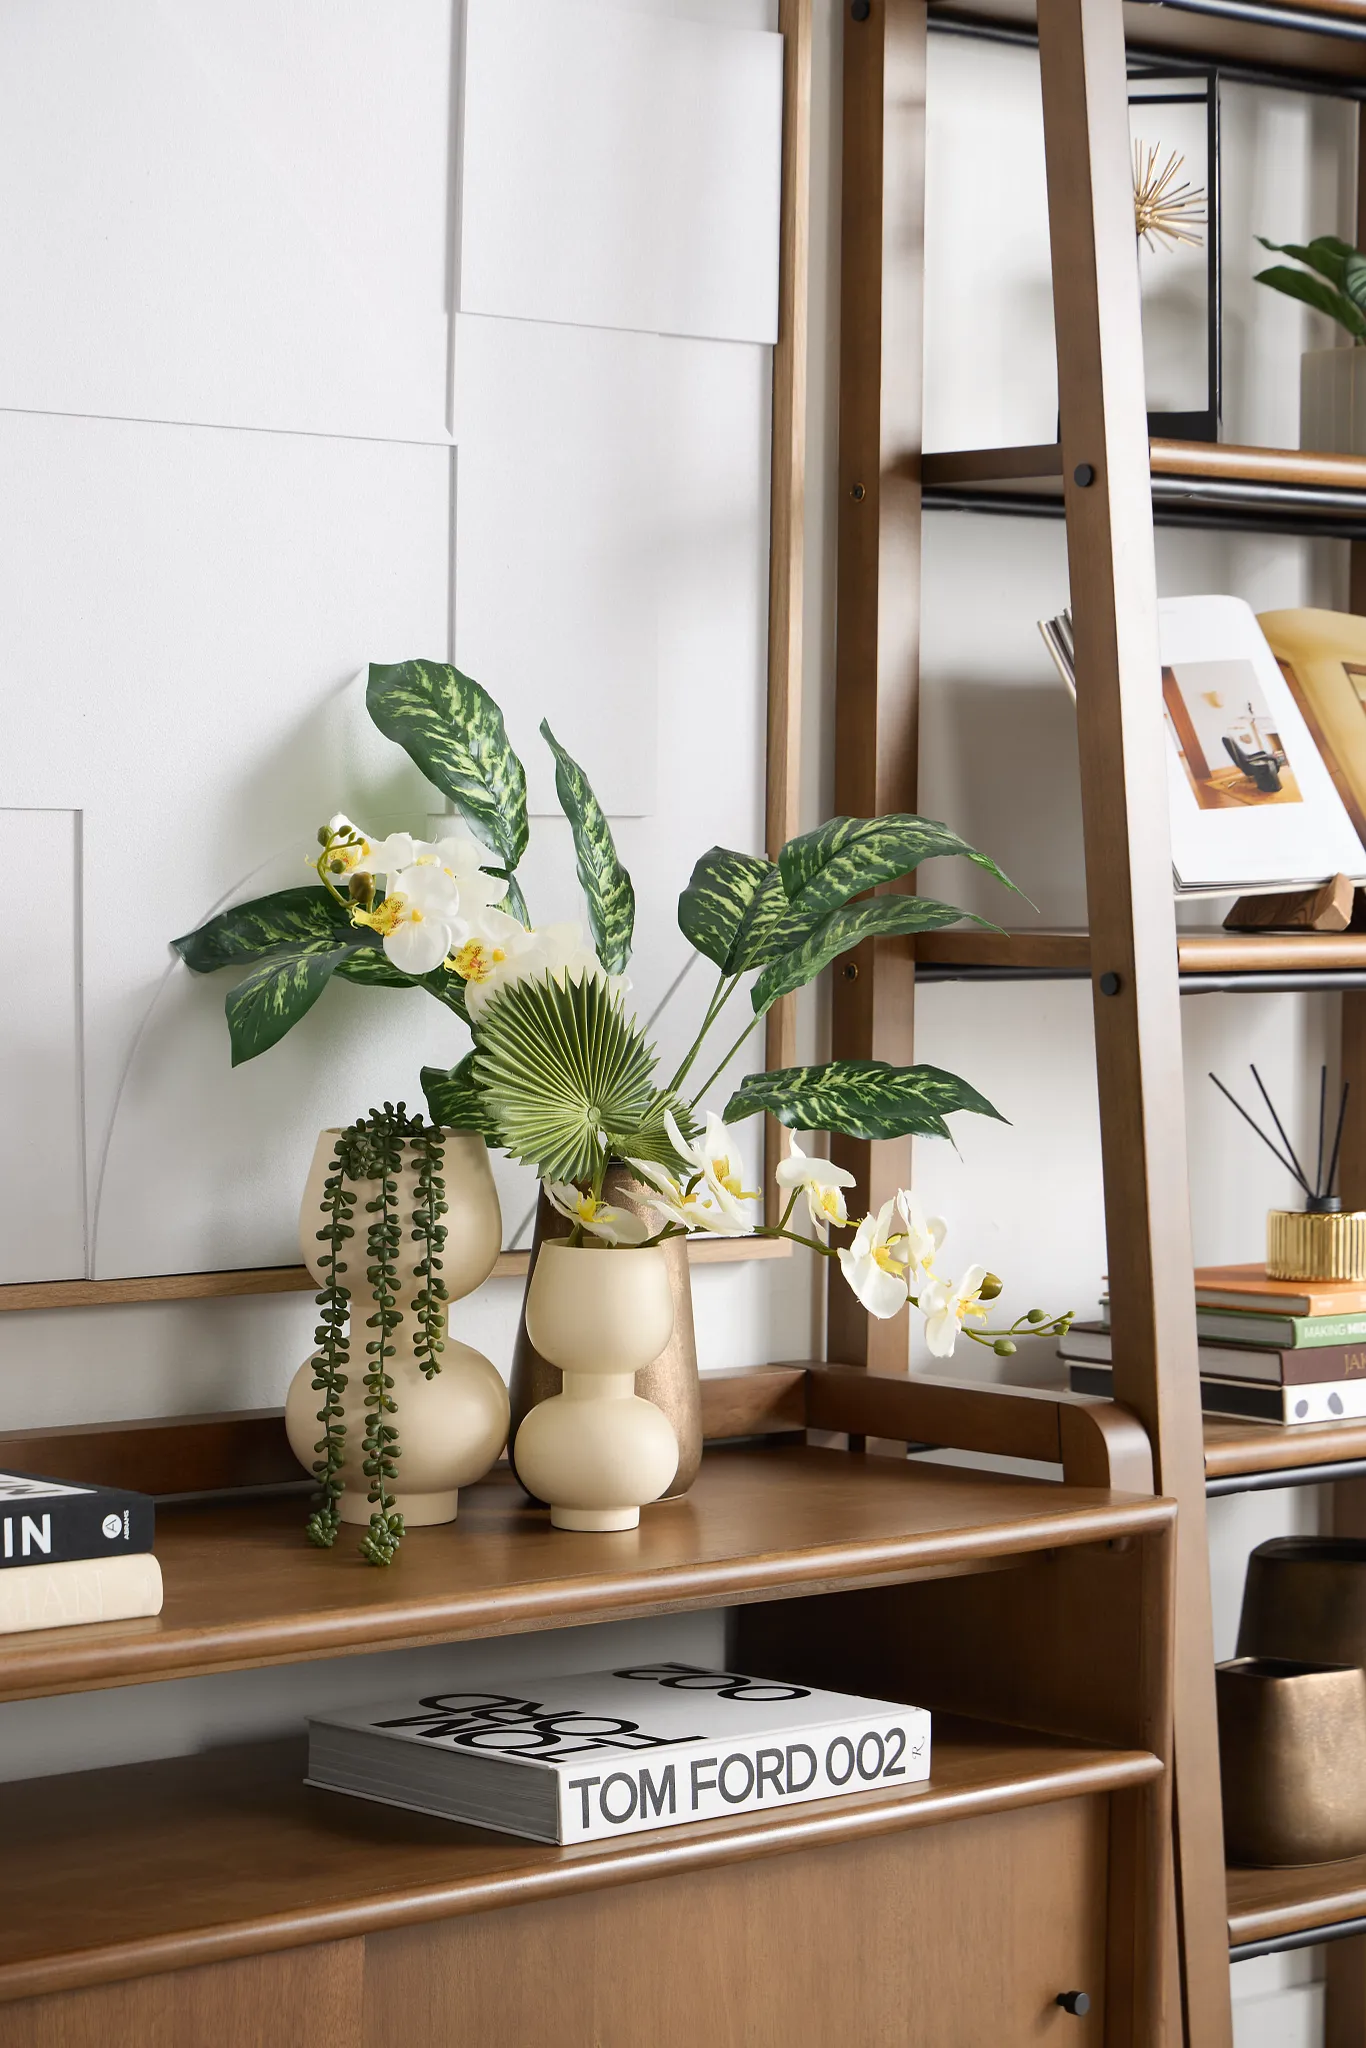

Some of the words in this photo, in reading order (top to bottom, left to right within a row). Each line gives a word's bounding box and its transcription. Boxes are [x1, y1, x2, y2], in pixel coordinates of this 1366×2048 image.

[1304, 1323, 1347, 1339] MAKING
[369, 1711, 608, 1763] TOM
[418, 1693, 709, 1751] FORD
[568, 1763, 677, 1829] TOM
[690, 1743, 818, 1811] FORD
